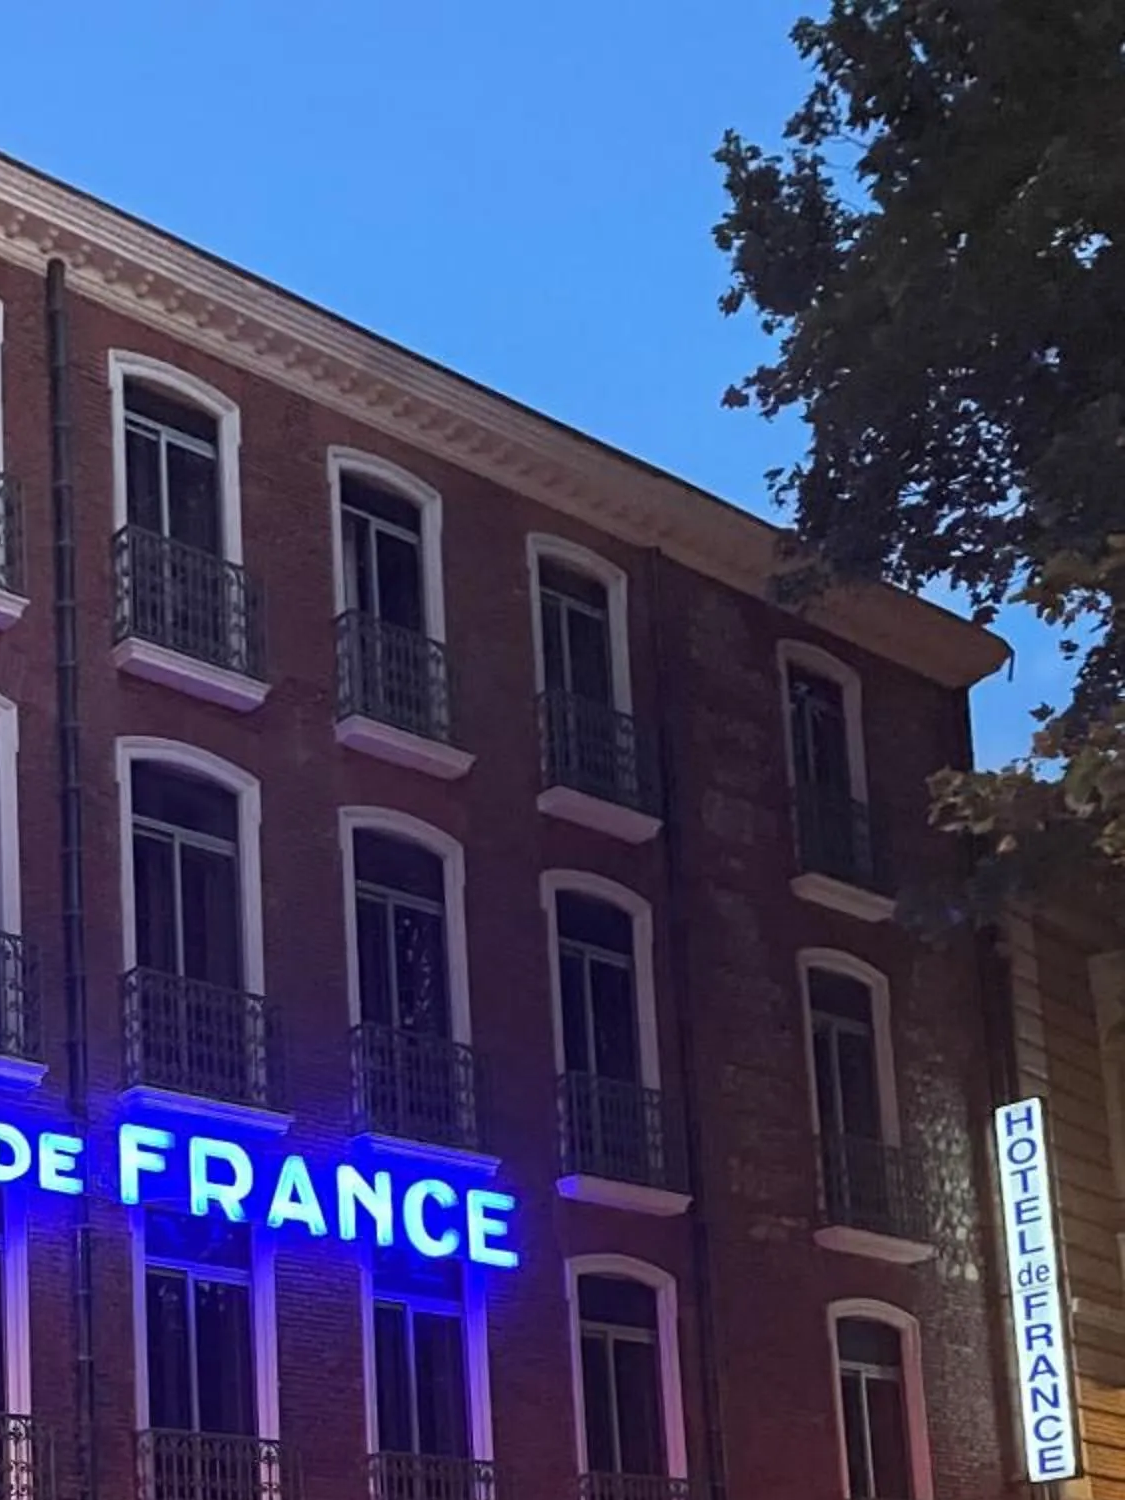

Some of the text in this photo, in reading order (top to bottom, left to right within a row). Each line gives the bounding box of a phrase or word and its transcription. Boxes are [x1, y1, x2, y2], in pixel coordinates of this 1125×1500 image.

[118, 1122, 520, 1268] FRANCE
[1005, 1105, 1066, 1476] HOTEL de FRANCE
